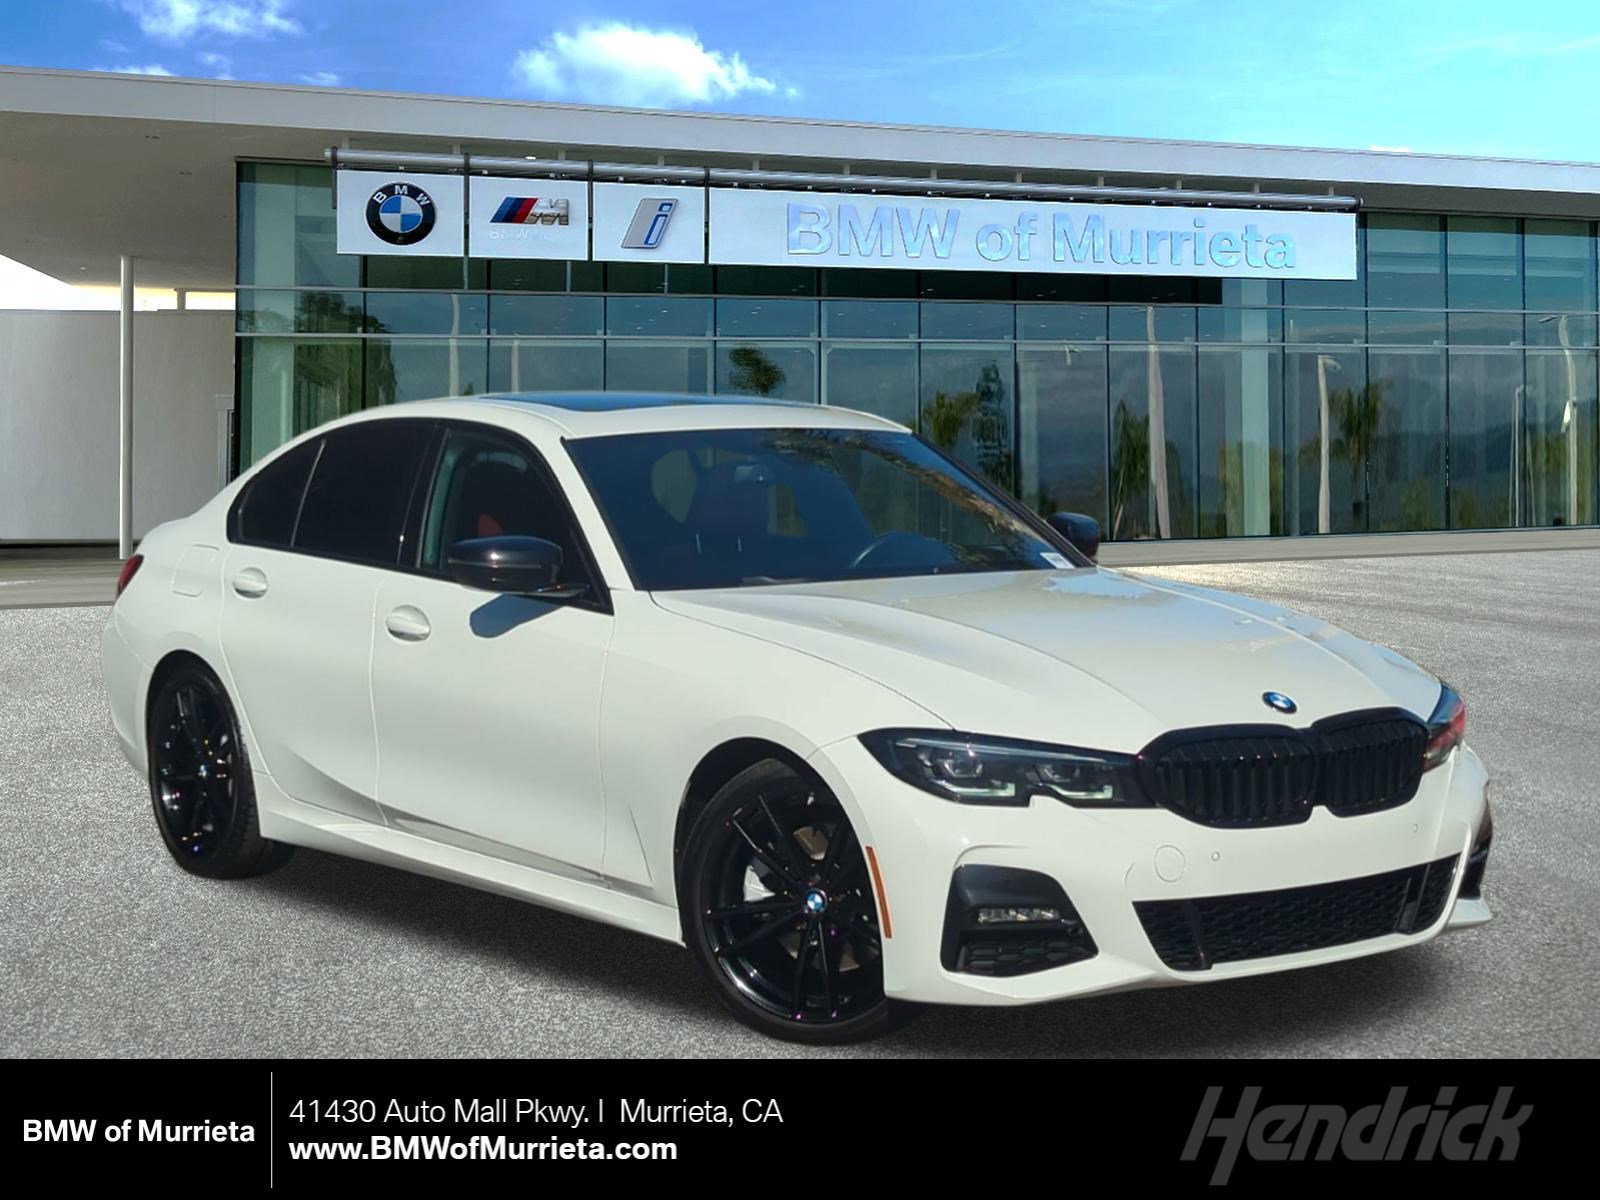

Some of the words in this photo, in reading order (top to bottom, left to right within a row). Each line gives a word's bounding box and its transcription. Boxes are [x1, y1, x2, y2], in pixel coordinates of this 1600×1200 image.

[373, 185, 430, 206] BMW
[786, 203, 961, 259] BMW
[975, 211, 1039, 262] of
[1053, 212, 1296, 269] Murrieta
